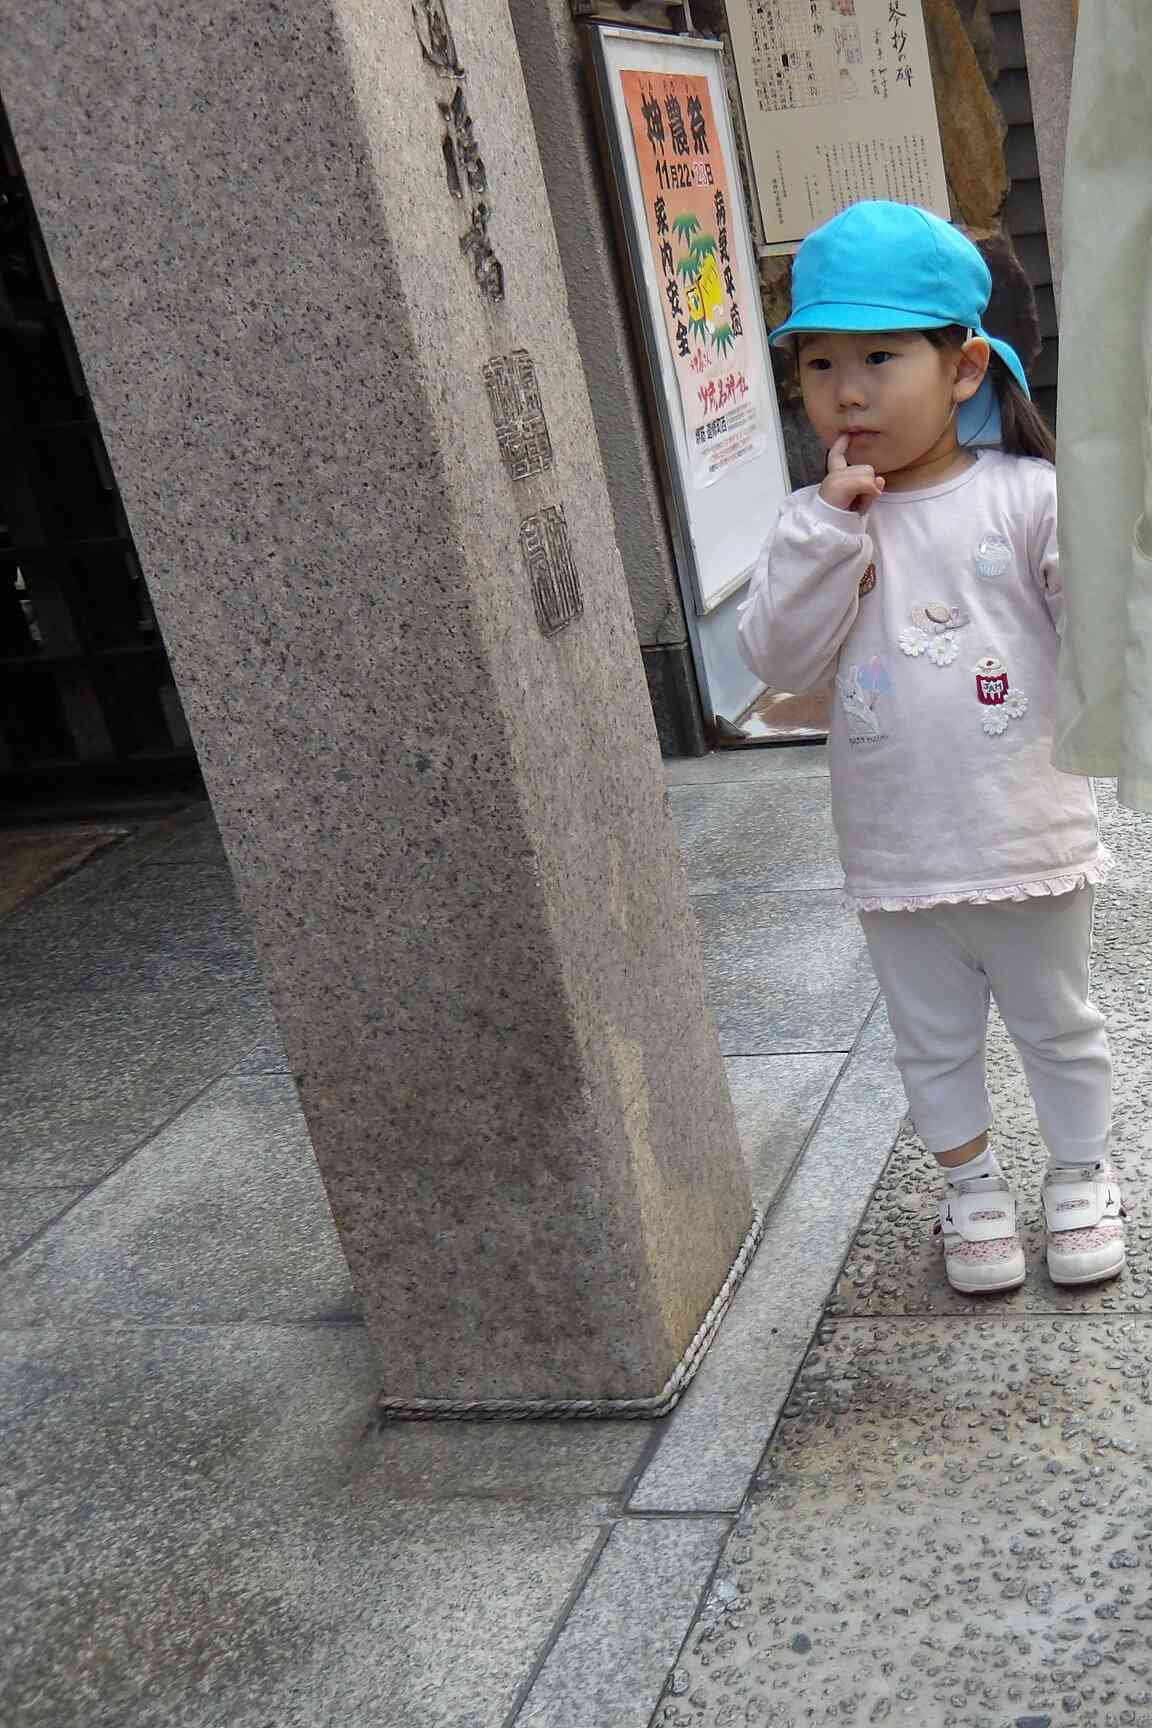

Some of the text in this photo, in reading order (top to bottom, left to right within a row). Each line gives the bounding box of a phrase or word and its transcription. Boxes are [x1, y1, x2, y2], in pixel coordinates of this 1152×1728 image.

[640, 92, 709, 156] 神農祭
[654, 194, 691, 357] 家内安全
[983, 682, 1002, 692] JAM
